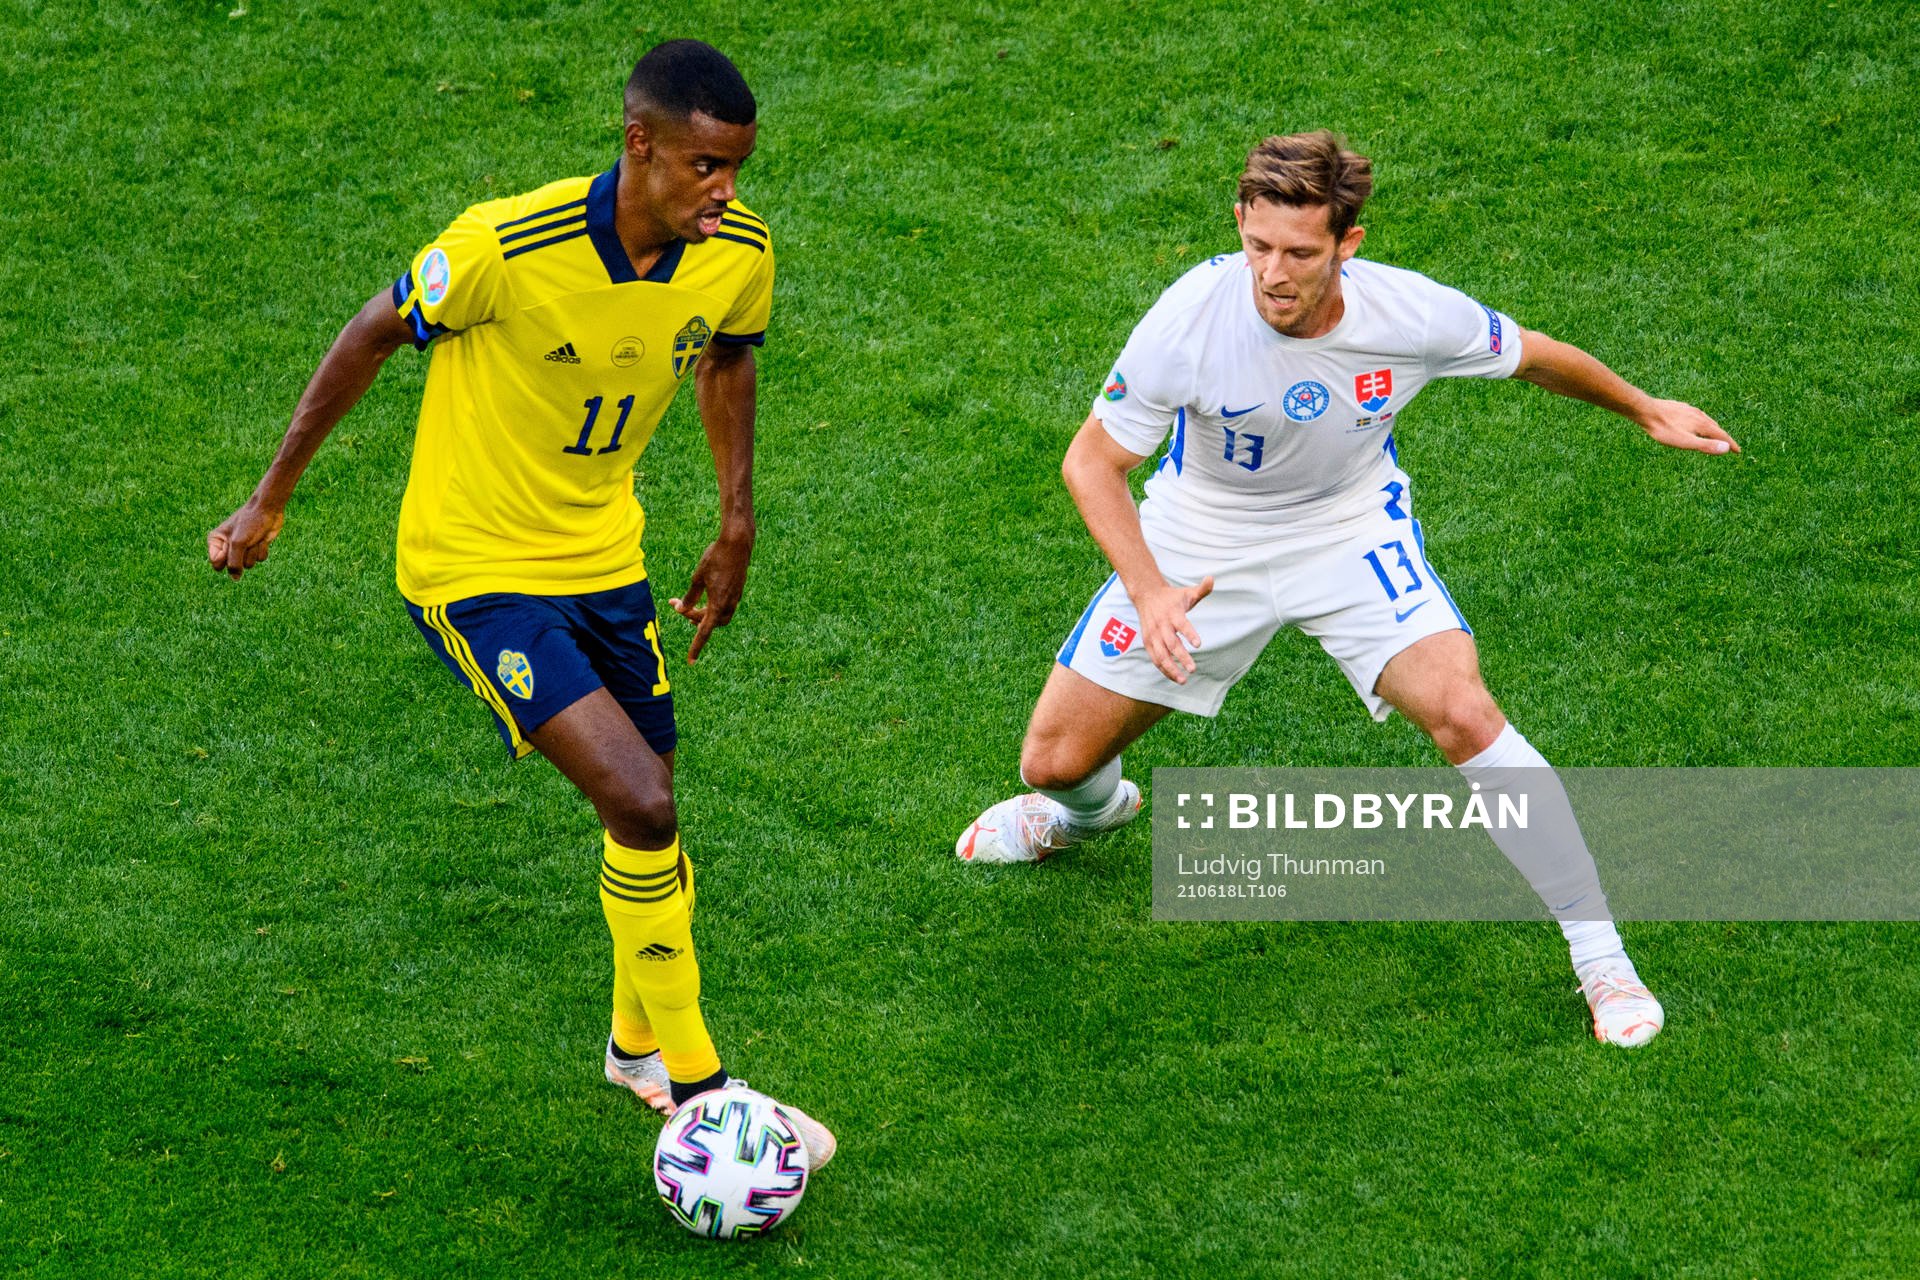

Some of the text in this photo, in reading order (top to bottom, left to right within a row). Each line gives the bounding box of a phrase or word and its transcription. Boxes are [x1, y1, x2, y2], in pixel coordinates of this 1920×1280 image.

[544, 354, 581, 364] adidas
[562, 394, 635, 456] 11
[1223, 426, 1265, 472] 13
[1362, 540, 1423, 602] 13
